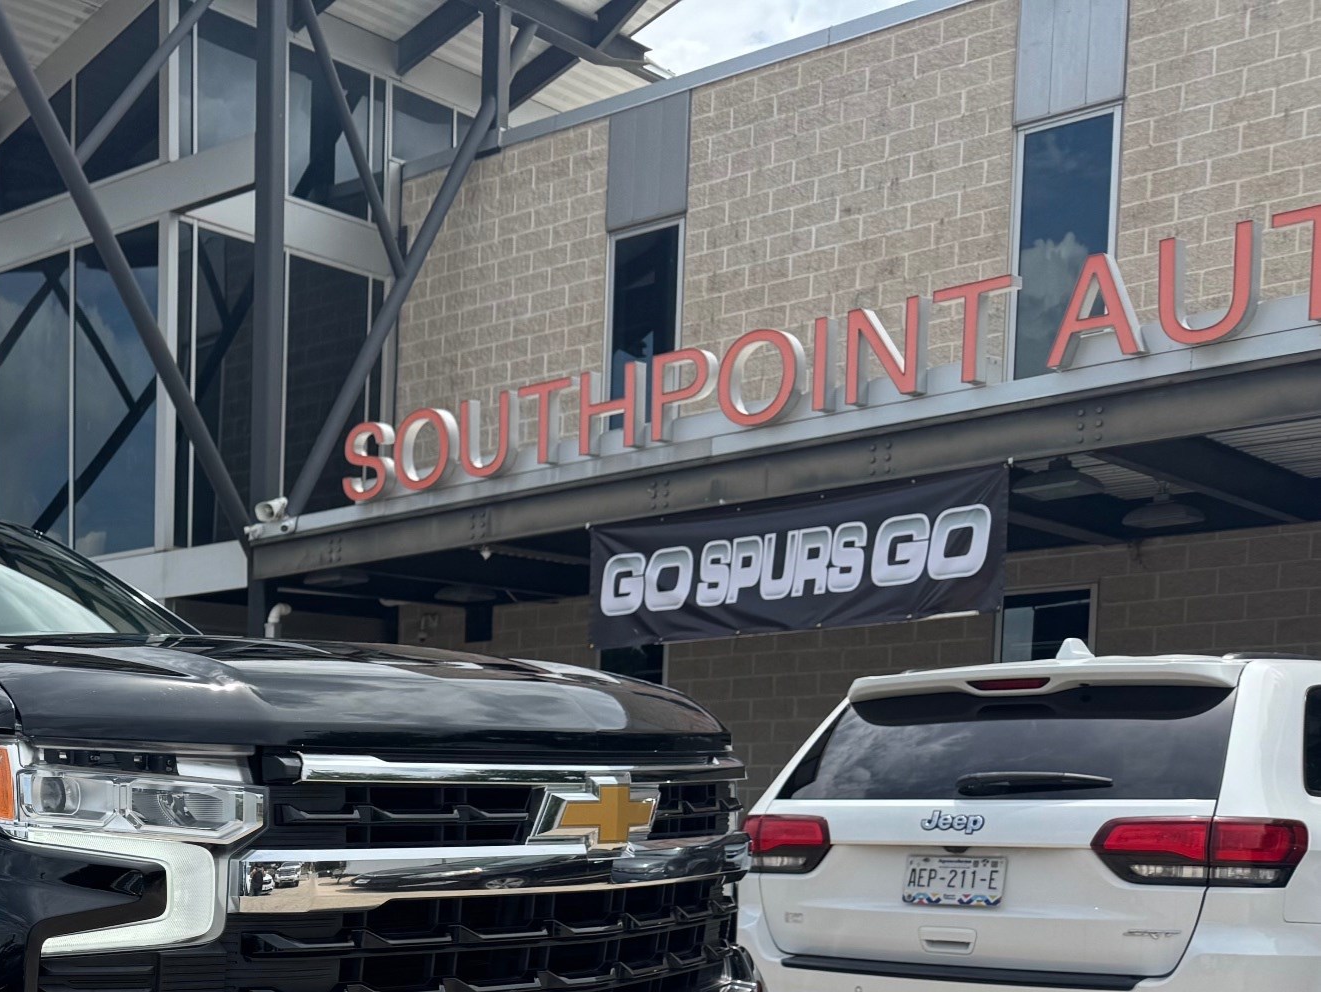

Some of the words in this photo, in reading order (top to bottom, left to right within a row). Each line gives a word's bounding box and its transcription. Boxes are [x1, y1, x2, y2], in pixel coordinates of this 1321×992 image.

[342, 274, 1020, 502] SOUTHPOINT
[599, 545, 693, 617] GO
[695, 521, 868, 607] SPURS
[870, 503, 992, 587] GO
[920, 809, 985, 835] Jeep
[907, 867, 999, 891] AEP-211-E
